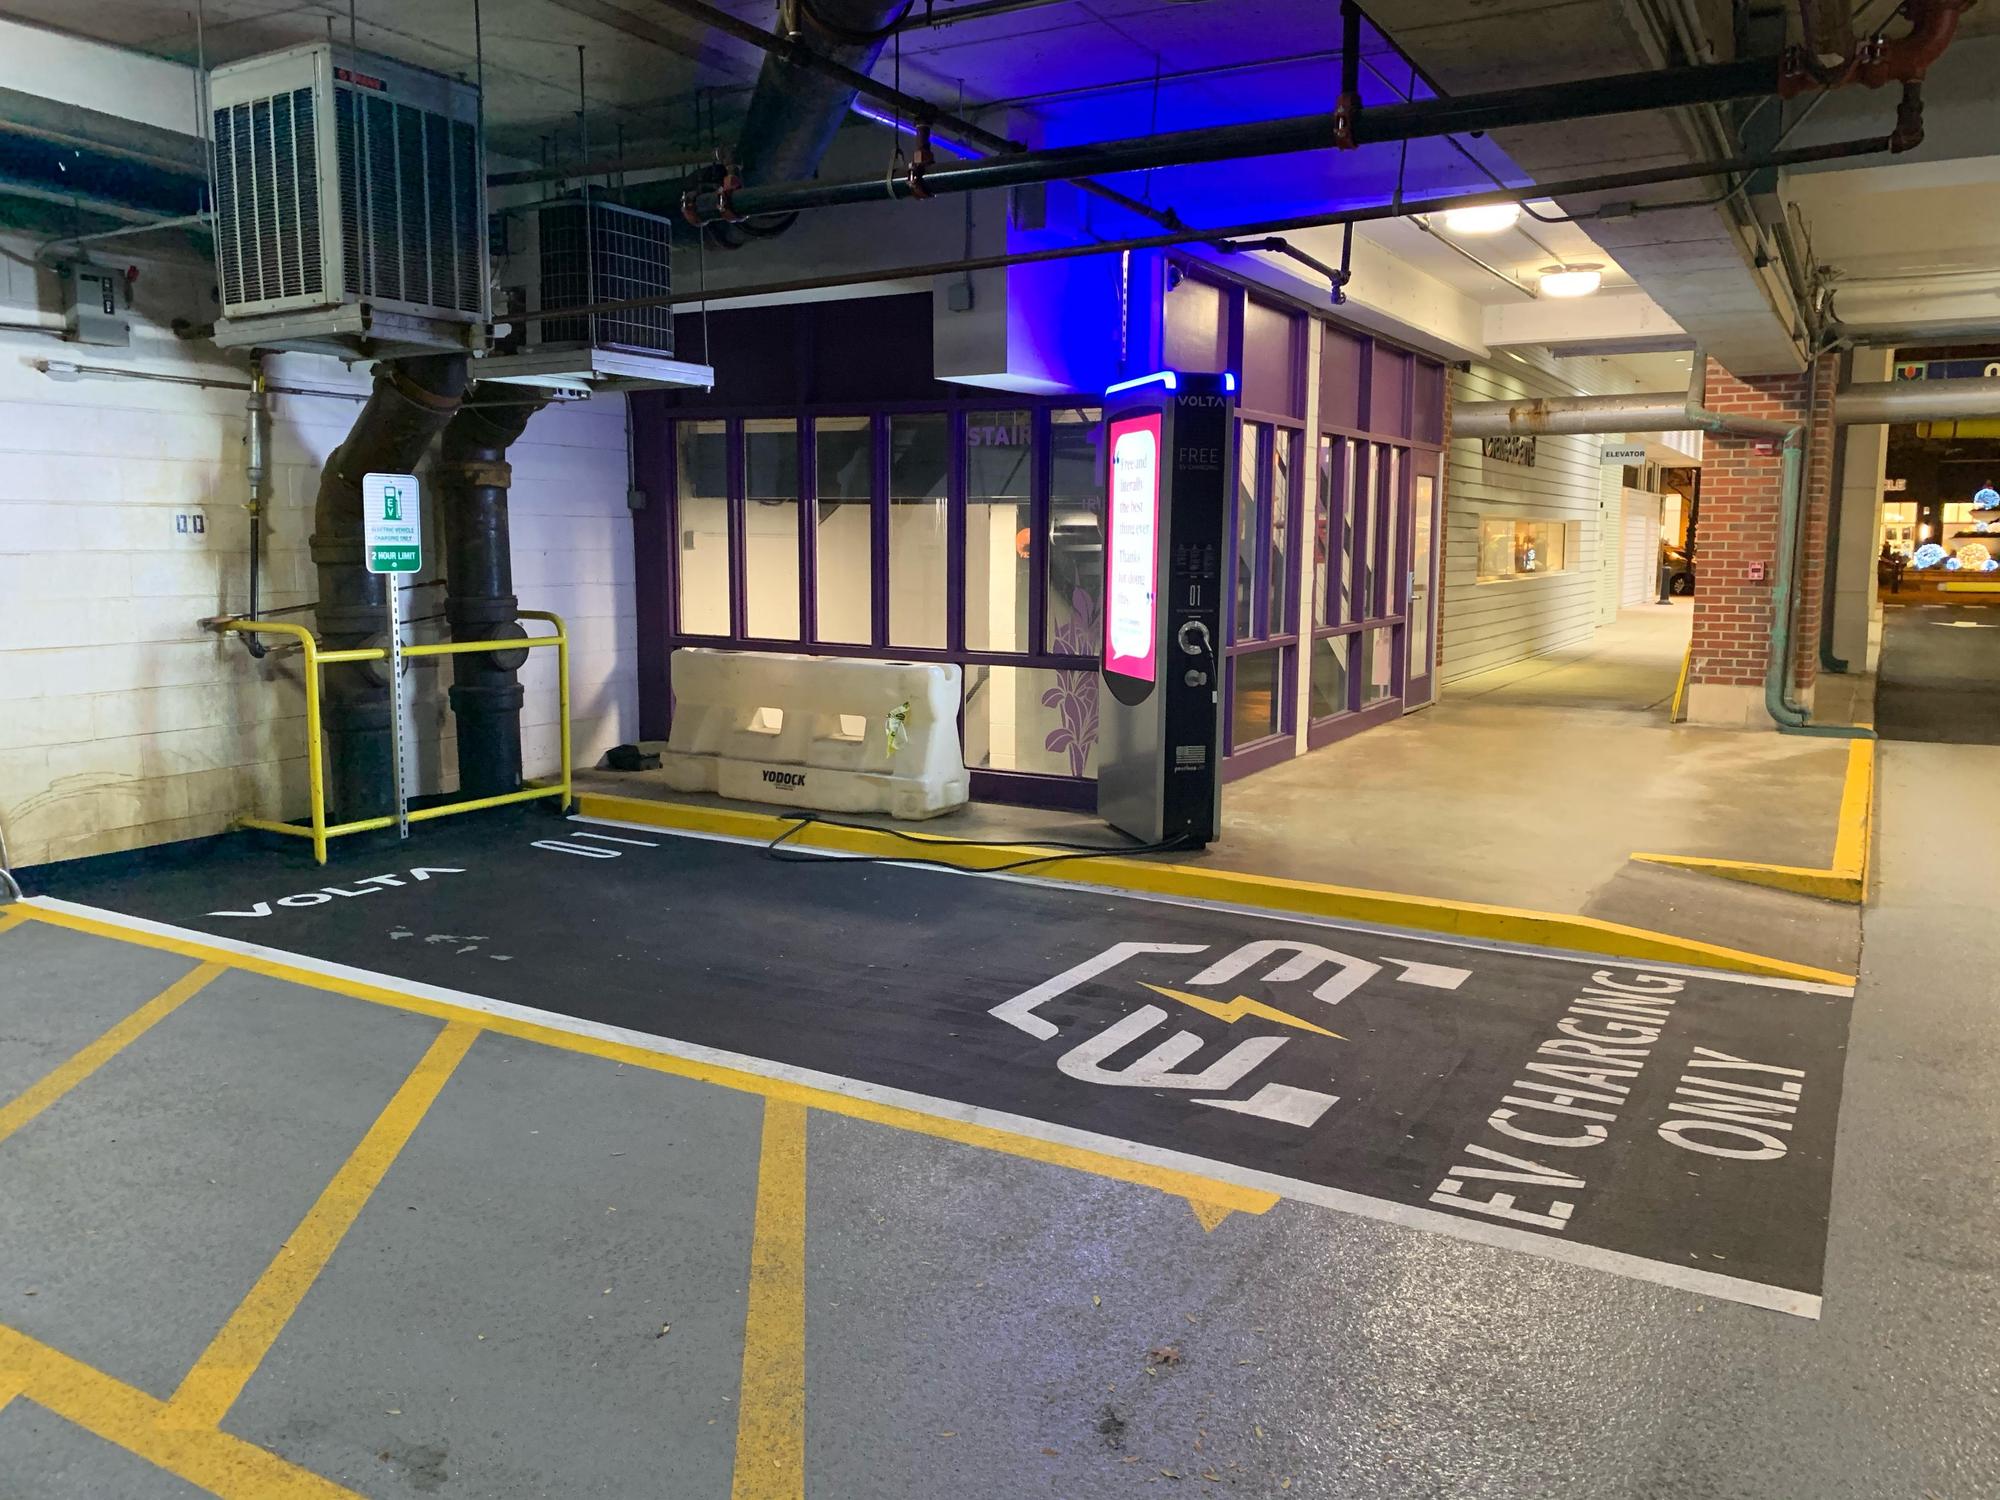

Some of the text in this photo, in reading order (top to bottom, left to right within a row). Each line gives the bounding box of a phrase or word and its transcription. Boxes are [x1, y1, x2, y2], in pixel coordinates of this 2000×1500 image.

[1177, 395, 1225, 408] VOLTA
[968, 426, 1031, 447] STAIR
[1135, 452, 1148, 469] and
[1179, 448, 1219, 463] FREE
[1605, 450, 1646, 458] ELEVATOR
[1130, 500, 1144, 513] best
[371, 552, 416, 560] 2 HOUR LIMIT
[1189, 584, 1201, 606] 01
[762, 770, 806, 787] YODOCK
[206, 867, 467, 917] VOLTA
[1429, 969, 1688, 1231] EV CHARGING
[1657, 1046, 1807, 1161] ONLY
